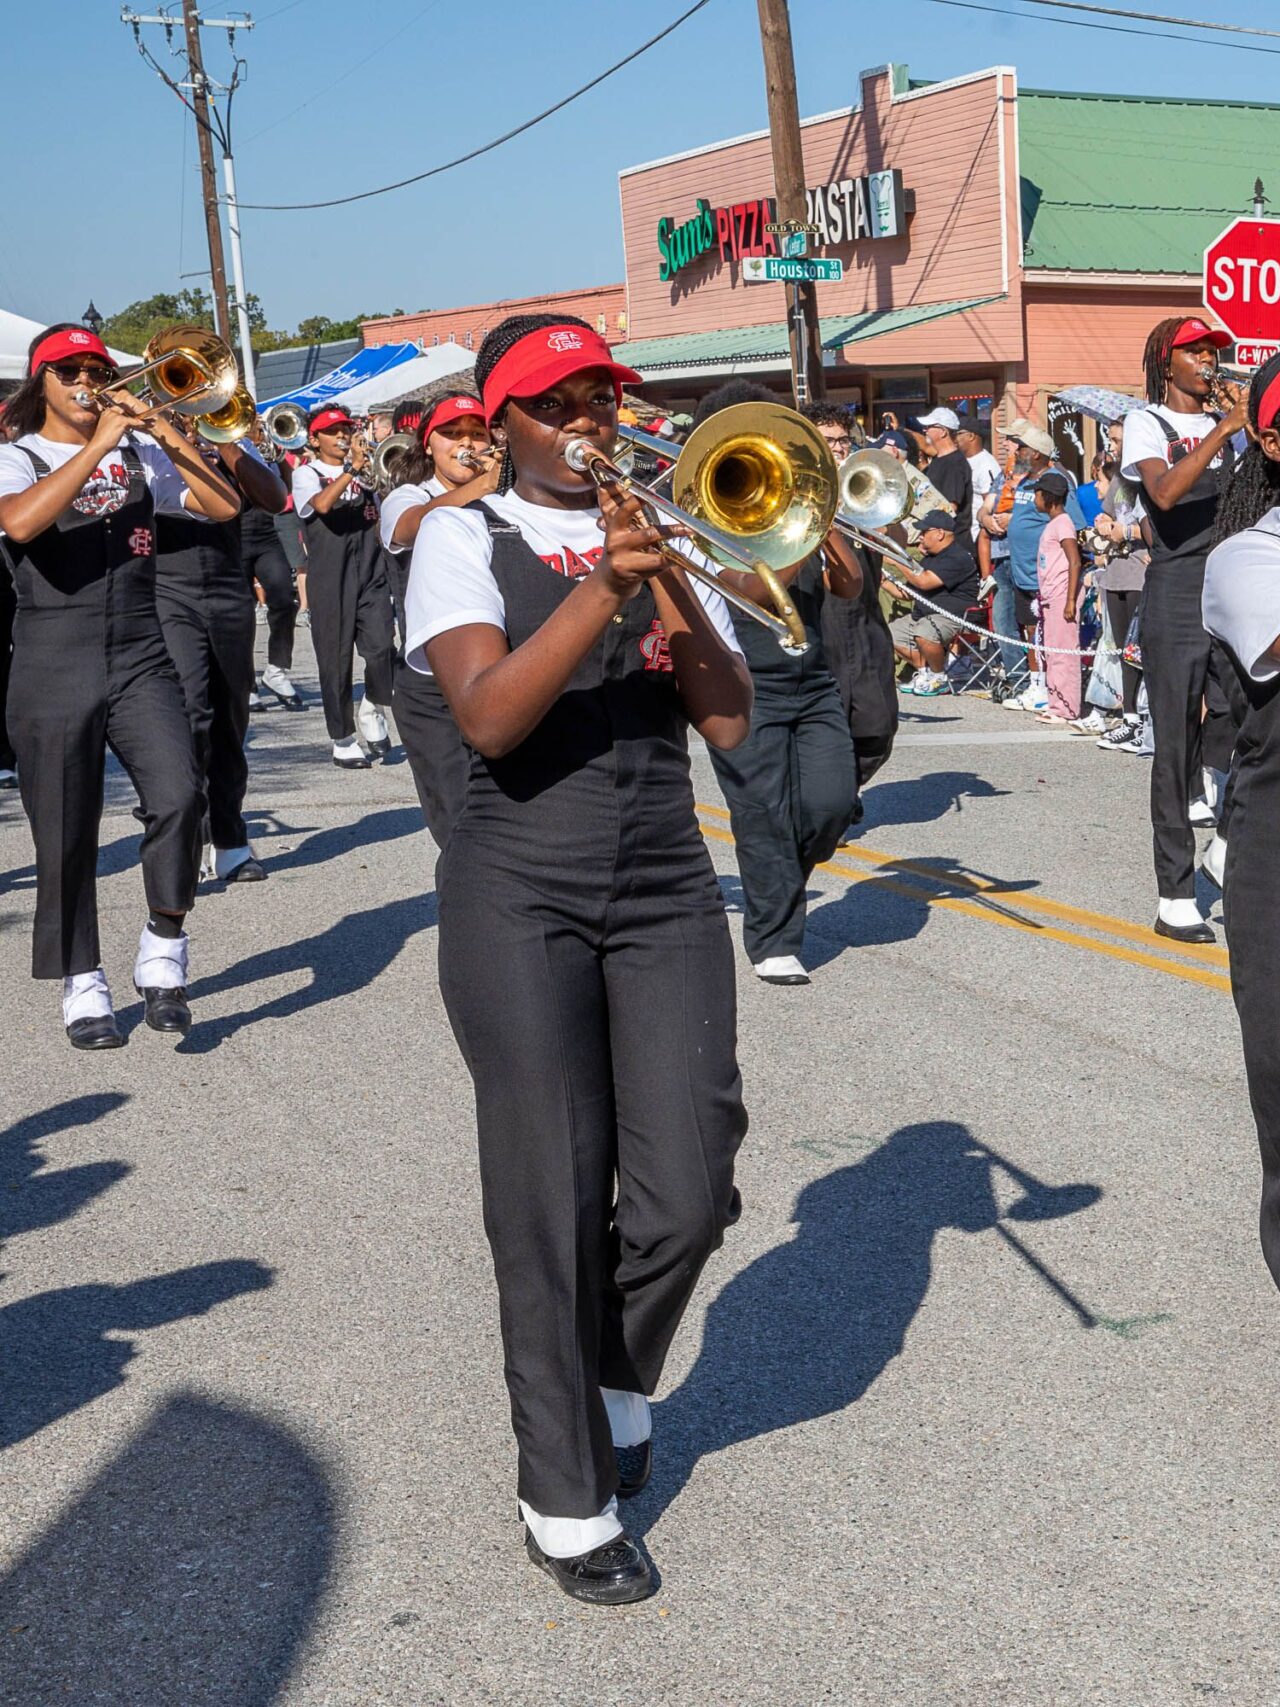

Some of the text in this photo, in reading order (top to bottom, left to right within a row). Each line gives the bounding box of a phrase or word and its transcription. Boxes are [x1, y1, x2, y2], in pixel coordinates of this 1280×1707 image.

[766, 224, 818, 232] OLD TOWN
[657, 198, 713, 282] Sam's
[715, 198, 777, 263] PIZZA
[769, 261, 838, 278] Houston St
[828, 270, 840, 279] 100
